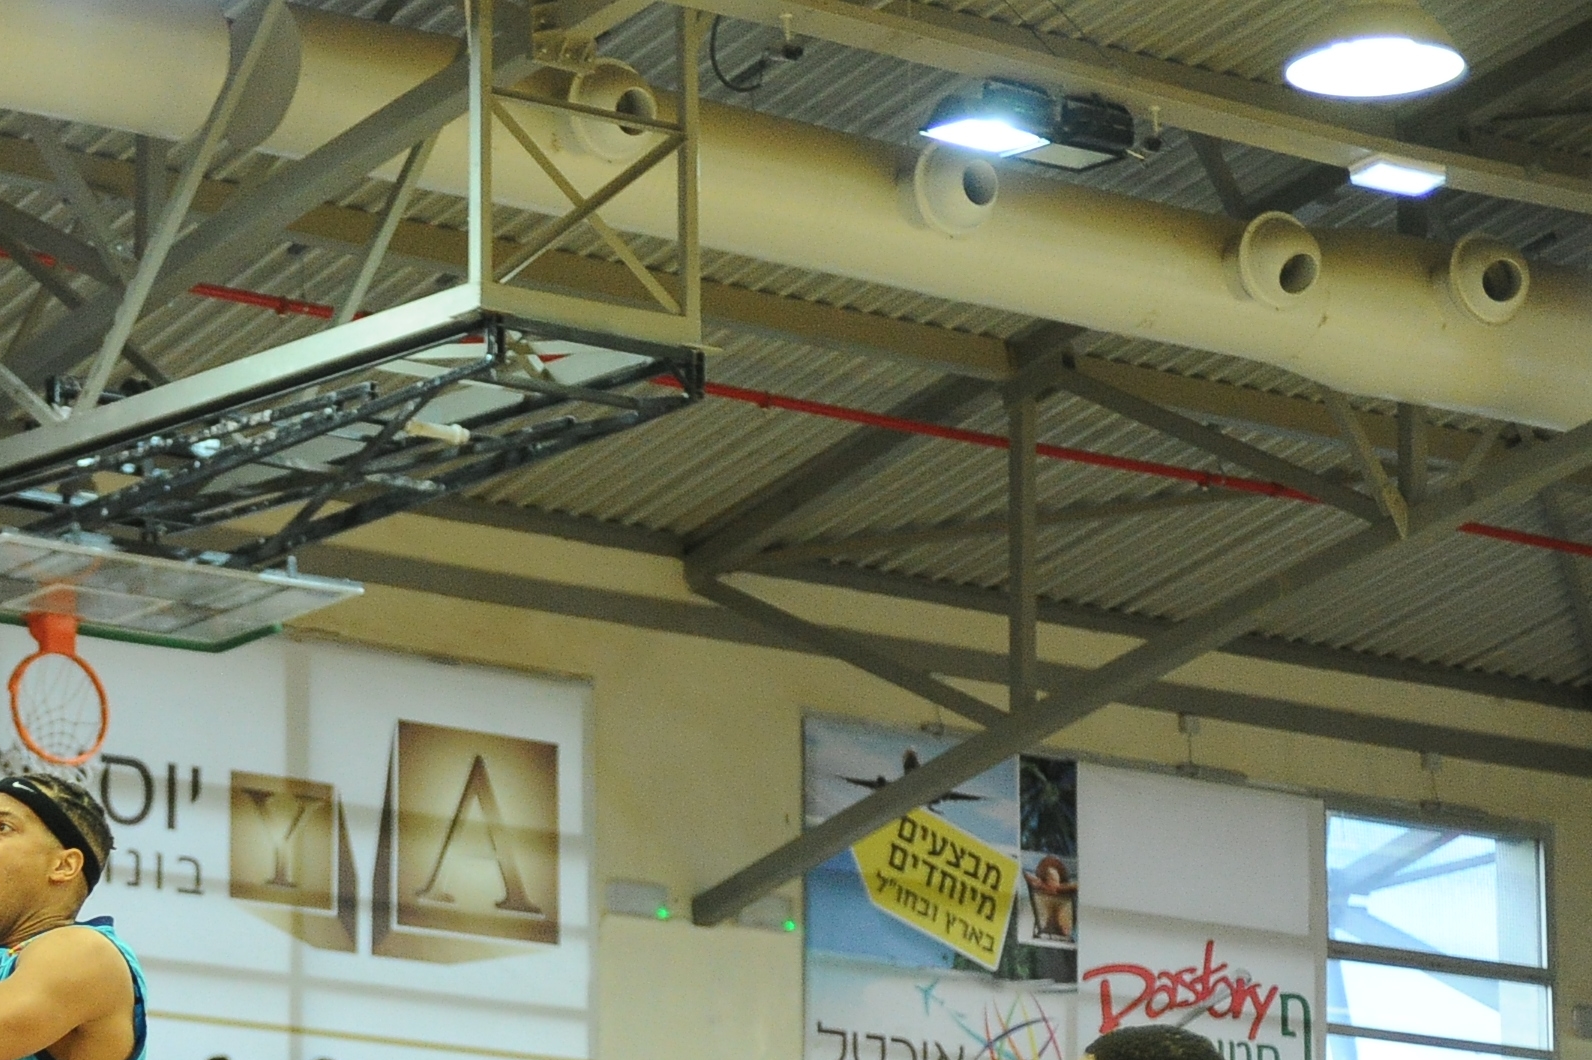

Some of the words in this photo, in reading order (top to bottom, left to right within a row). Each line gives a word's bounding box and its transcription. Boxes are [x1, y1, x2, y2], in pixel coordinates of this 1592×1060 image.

[101, 753, 202, 830] יוס
[888, 843, 997, 922] מיוחדים
[897, 815, 1002, 891] מבצעים
[945, 911, 995, 954] בארץ
